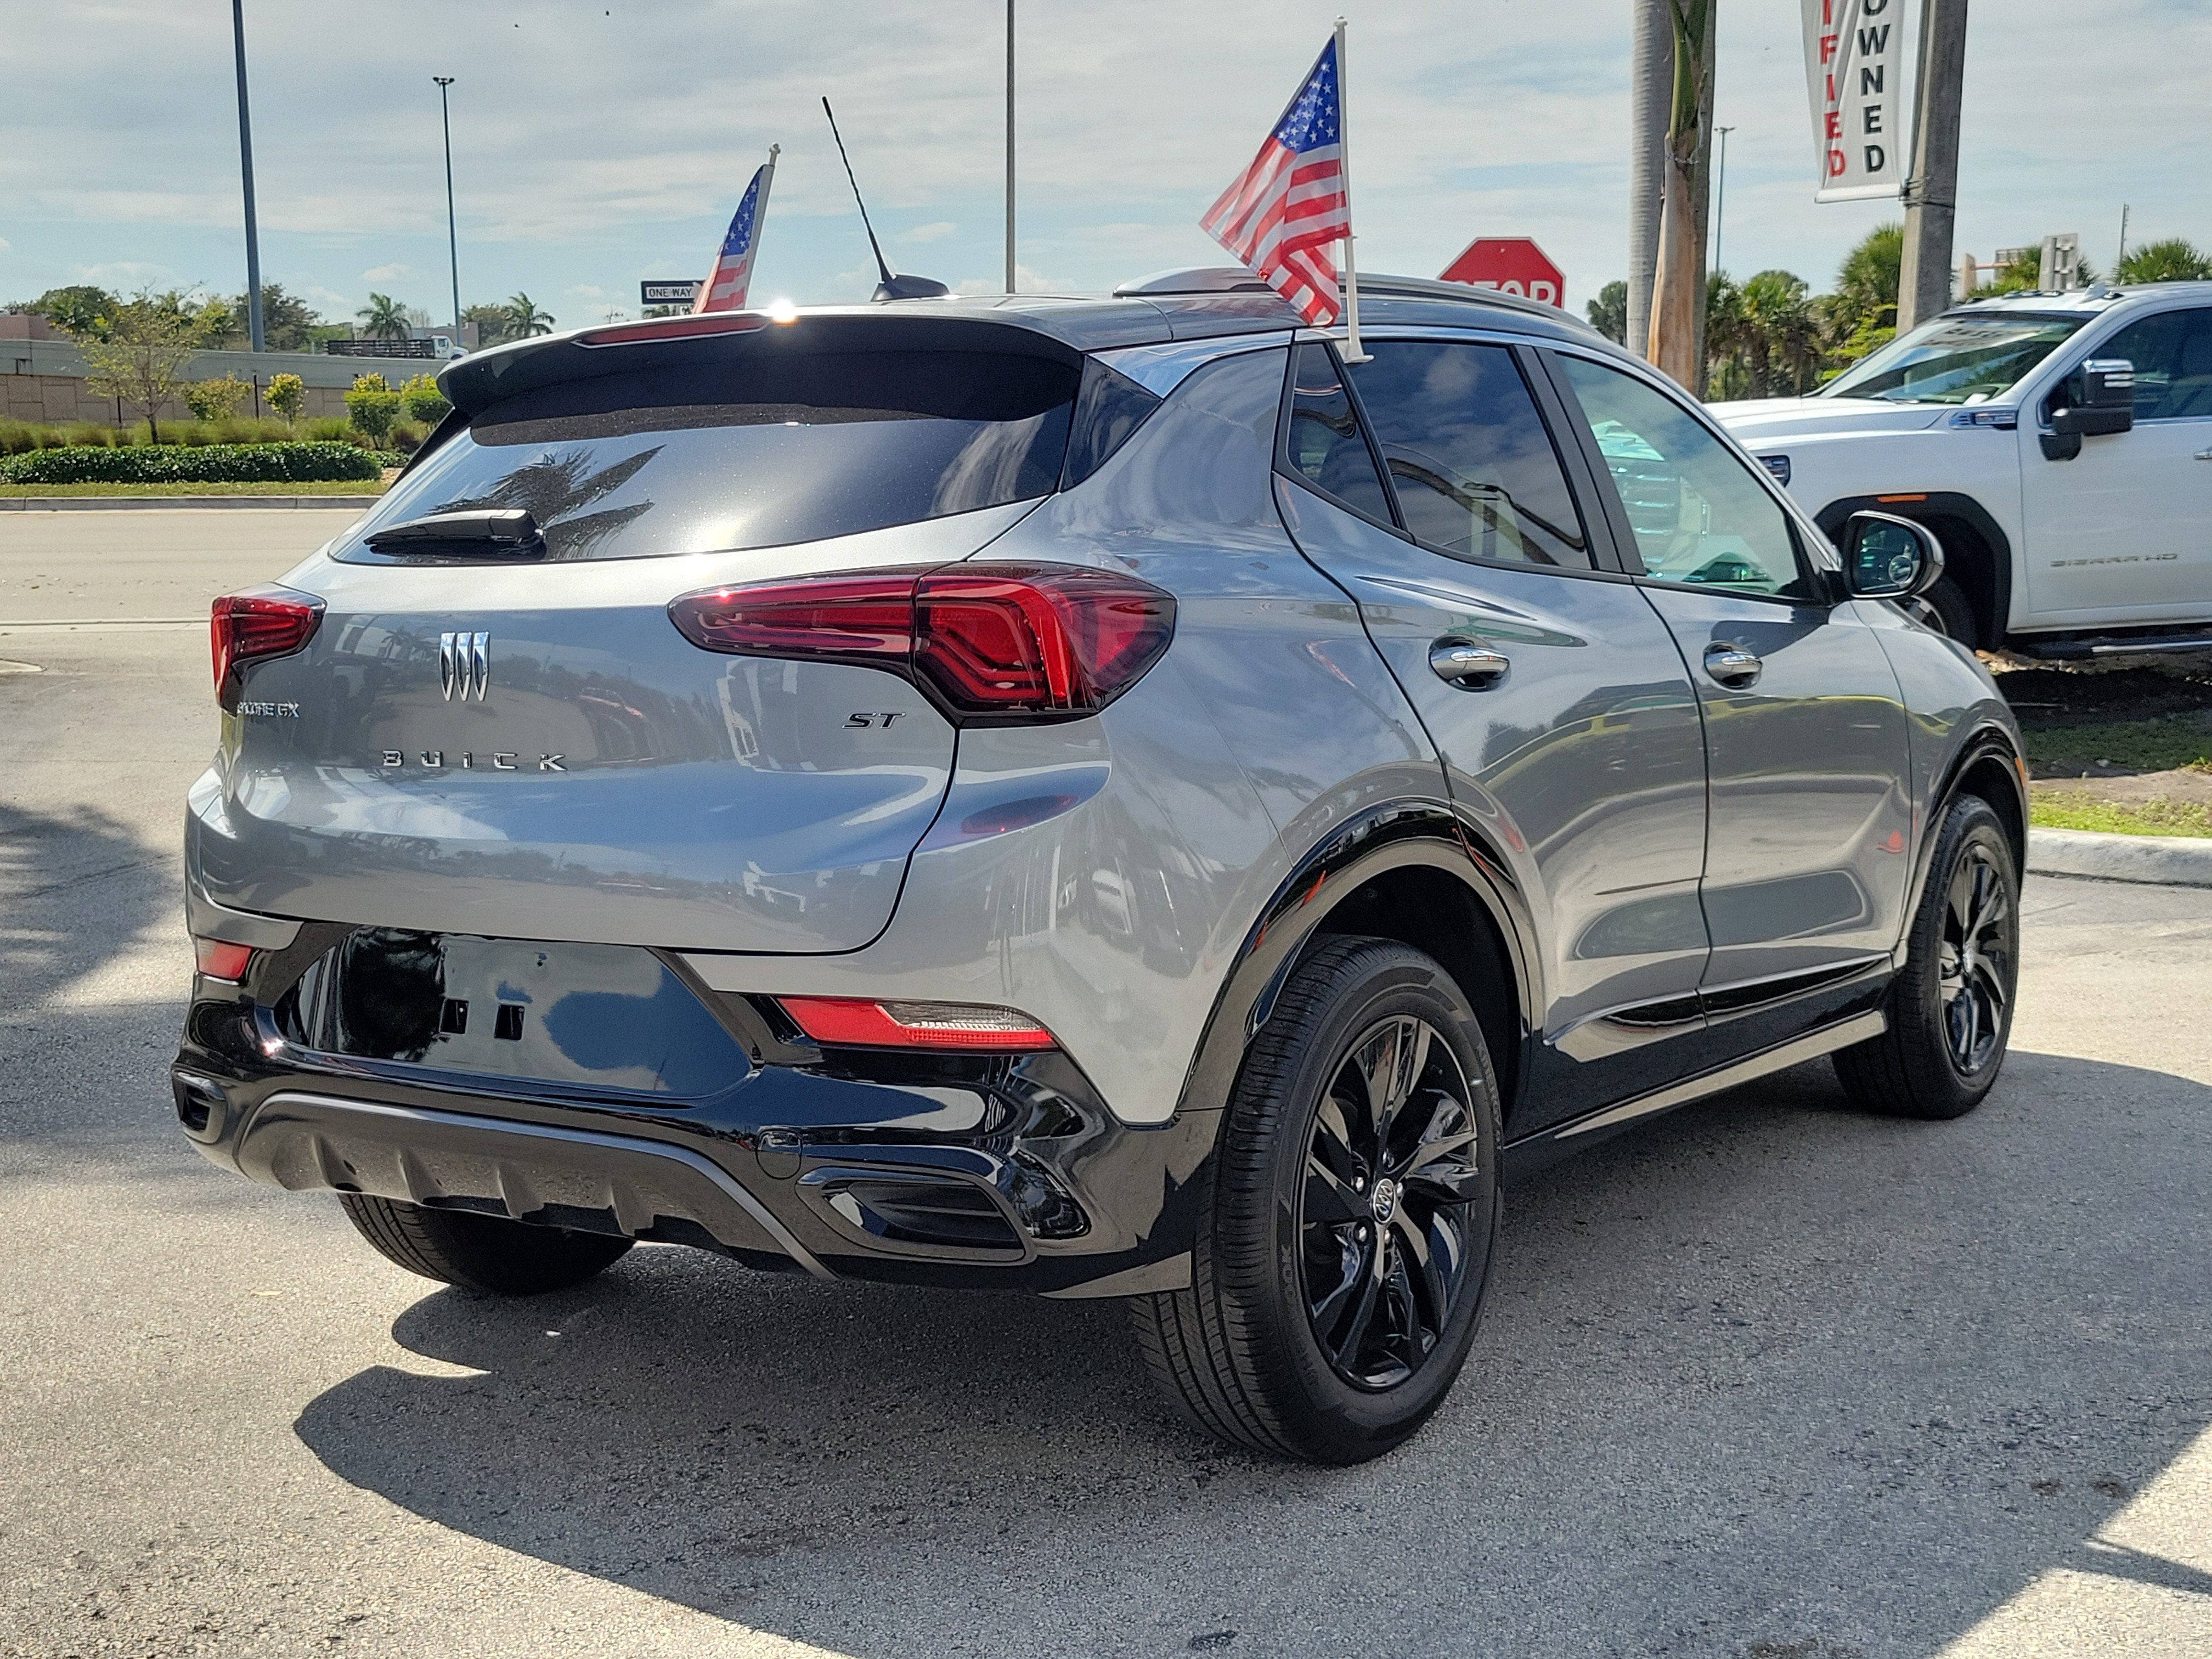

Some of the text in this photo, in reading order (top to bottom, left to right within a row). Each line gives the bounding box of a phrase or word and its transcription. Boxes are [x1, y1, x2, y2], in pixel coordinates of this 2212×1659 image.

[649, 287, 692, 297] ONE WAY
[277, 702, 300, 718] GX
[842, 712, 906, 729] ST
[383, 751, 567, 771] BUICK
